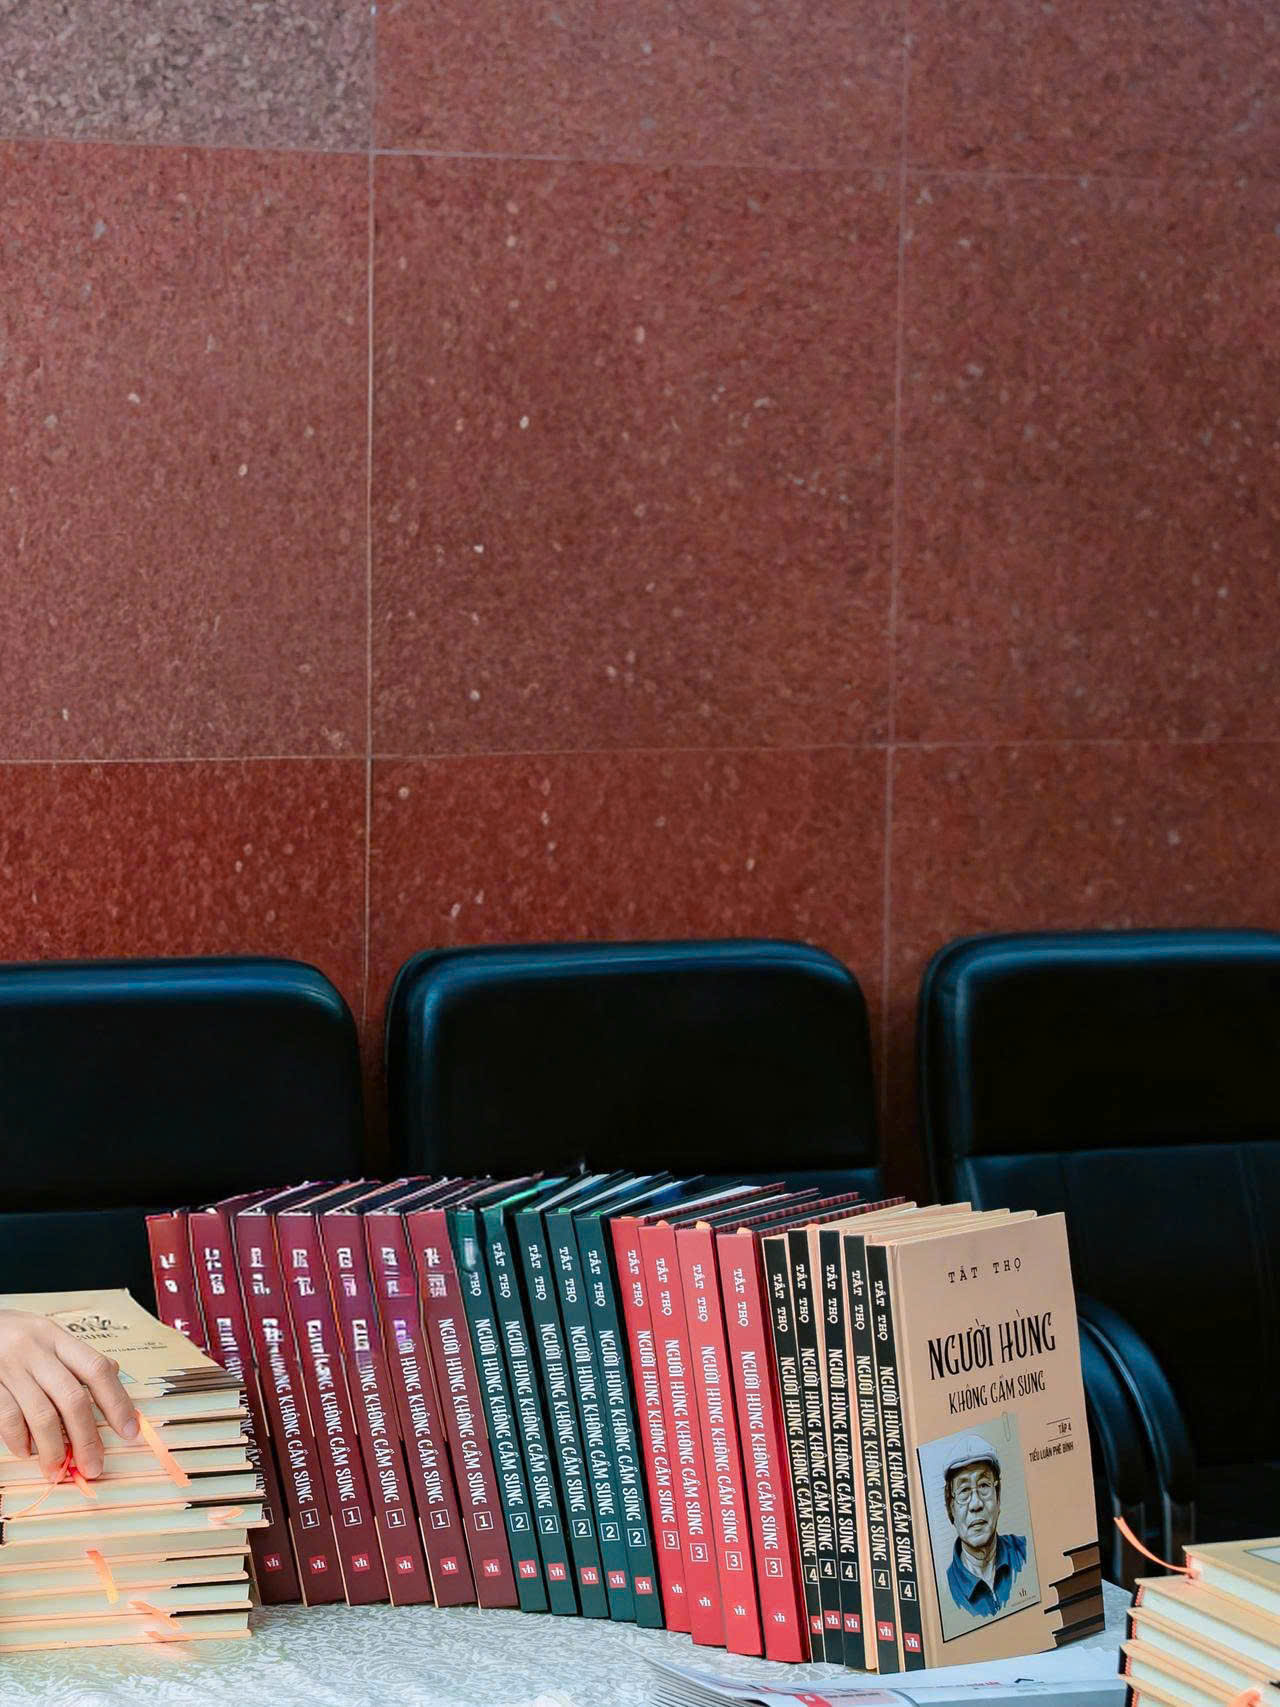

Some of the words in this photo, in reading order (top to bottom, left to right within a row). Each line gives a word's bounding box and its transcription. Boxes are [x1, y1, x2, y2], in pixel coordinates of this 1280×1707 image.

[992, 1257, 1021, 1274] THỌ
[469, 1271, 482, 1296] THỌ
[499, 1273, 511, 1298] THỌ
[535, 1275, 547, 1300] THỌ
[565, 1278, 577, 1303] THỌ
[594, 1281, 606, 1307] THỌ
[633, 1281, 644, 1307] THỌ
[661, 1290, 672, 1316] THỌ
[697, 1296, 708, 1322] THỌ
[738, 1301, 749, 1327] THỌ
[777, 1306, 788, 1332] THỌ
[799, 1297, 809, 1323] THỌ
[827, 1297, 838, 1324] THỌ
[855, 1304, 865, 1330] THỌ
[877, 1314, 888, 1341] THỌ
[927, 1318, 994, 1381] NGƯỜI
[998, 1309, 1056, 1364] HÙNG
[446, 1357, 466, 1392] HÙNG
[483, 1357, 503, 1393] HÙNG
[513, 1359, 532, 1395] HÙNG
[547, 1362, 567, 1398] HÙNG
[577, 1365, 596, 1400] HÙNG
[605, 1370, 624, 1405] HÙNG
[948, 1383, 988, 1414] KHÔNG
[1018, 1369, 1046, 1396] SÚNG
[671, 1381, 688, 1416] HÙNG
[706, 1387, 724, 1423] HÙNG
[746, 1393, 764, 1429] HÙNG
[805, 1391, 822, 1427] HÙNG
[831, 1391, 849, 1429] HÙNG
[453, 1394, 475, 1438] KHÔNG
[490, 1395, 511, 1438] KHÔNG
[520, 1397, 540, 1440] KHÔNG
[554, 1400, 575, 1444] KHÔNG
[583, 1403, 604, 1447] KHÔNG
[611, 1408, 631, 1452] KHÔNG
[785, 1399, 803, 1435] HÙNG
[860, 1398, 877, 1436] HÙNG
[884, 1409, 902, 1447] HÙNG
[675, 1420, 694, 1464] KHÔNG
[712, 1427, 730, 1472] KHÔNG
[751, 1433, 770, 1477] KHÔNG
[809, 1431, 827, 1477] KHÔNG
[834, 1433, 852, 1479] KHÔNG
[648, 1409, 666, 1453] KHÔNG
[658, 1489, 675, 1523] SÚNG
[864, 1440, 882, 1486] KHÔNG
[888, 1451, 907, 1498] KHÔNG
[468, 1471, 487, 1505] SÚNG
[504, 1472, 524, 1506] SÚNG
[534, 1475, 552, 1508] SÚNG
[567, 1478, 586, 1512] SÚNG
[596, 1482, 615, 1515] SÚNG
[623, 1487, 641, 1521] SÚNG
[479, 1515, 489, 1527] 1
[515, 1516, 525, 1528] 2
[545, 1518, 554, 1531] 2
[578, 1522, 587, 1534] 2
[606, 1525, 615, 1538] 2
[686, 1501, 704, 1535] SÚNG
[721, 1508, 739, 1543] SÚNG
[761, 1515, 779, 1549] SÚNG
[817, 1515, 833, 1550] SÚNG
[839, 1517, 856, 1553] SÚNG
[633, 1531, 642, 1543] 2
[668, 1533, 675, 1546] 3
[695, 1546, 704, 1559] 3
[871, 1525, 888, 1561] SÚNG
[896, 1536, 914, 1572] SÚNG
[730, 1554, 739, 1567] 3
[770, 1561, 778, 1574] 3
[810, 1568, 818, 1581] 4
[824, 1562, 833, 1575] 4
[845, 1564, 853, 1578] 4
[878, 1572, 888, 1586] 4
[904, 1583, 914, 1597] 4
